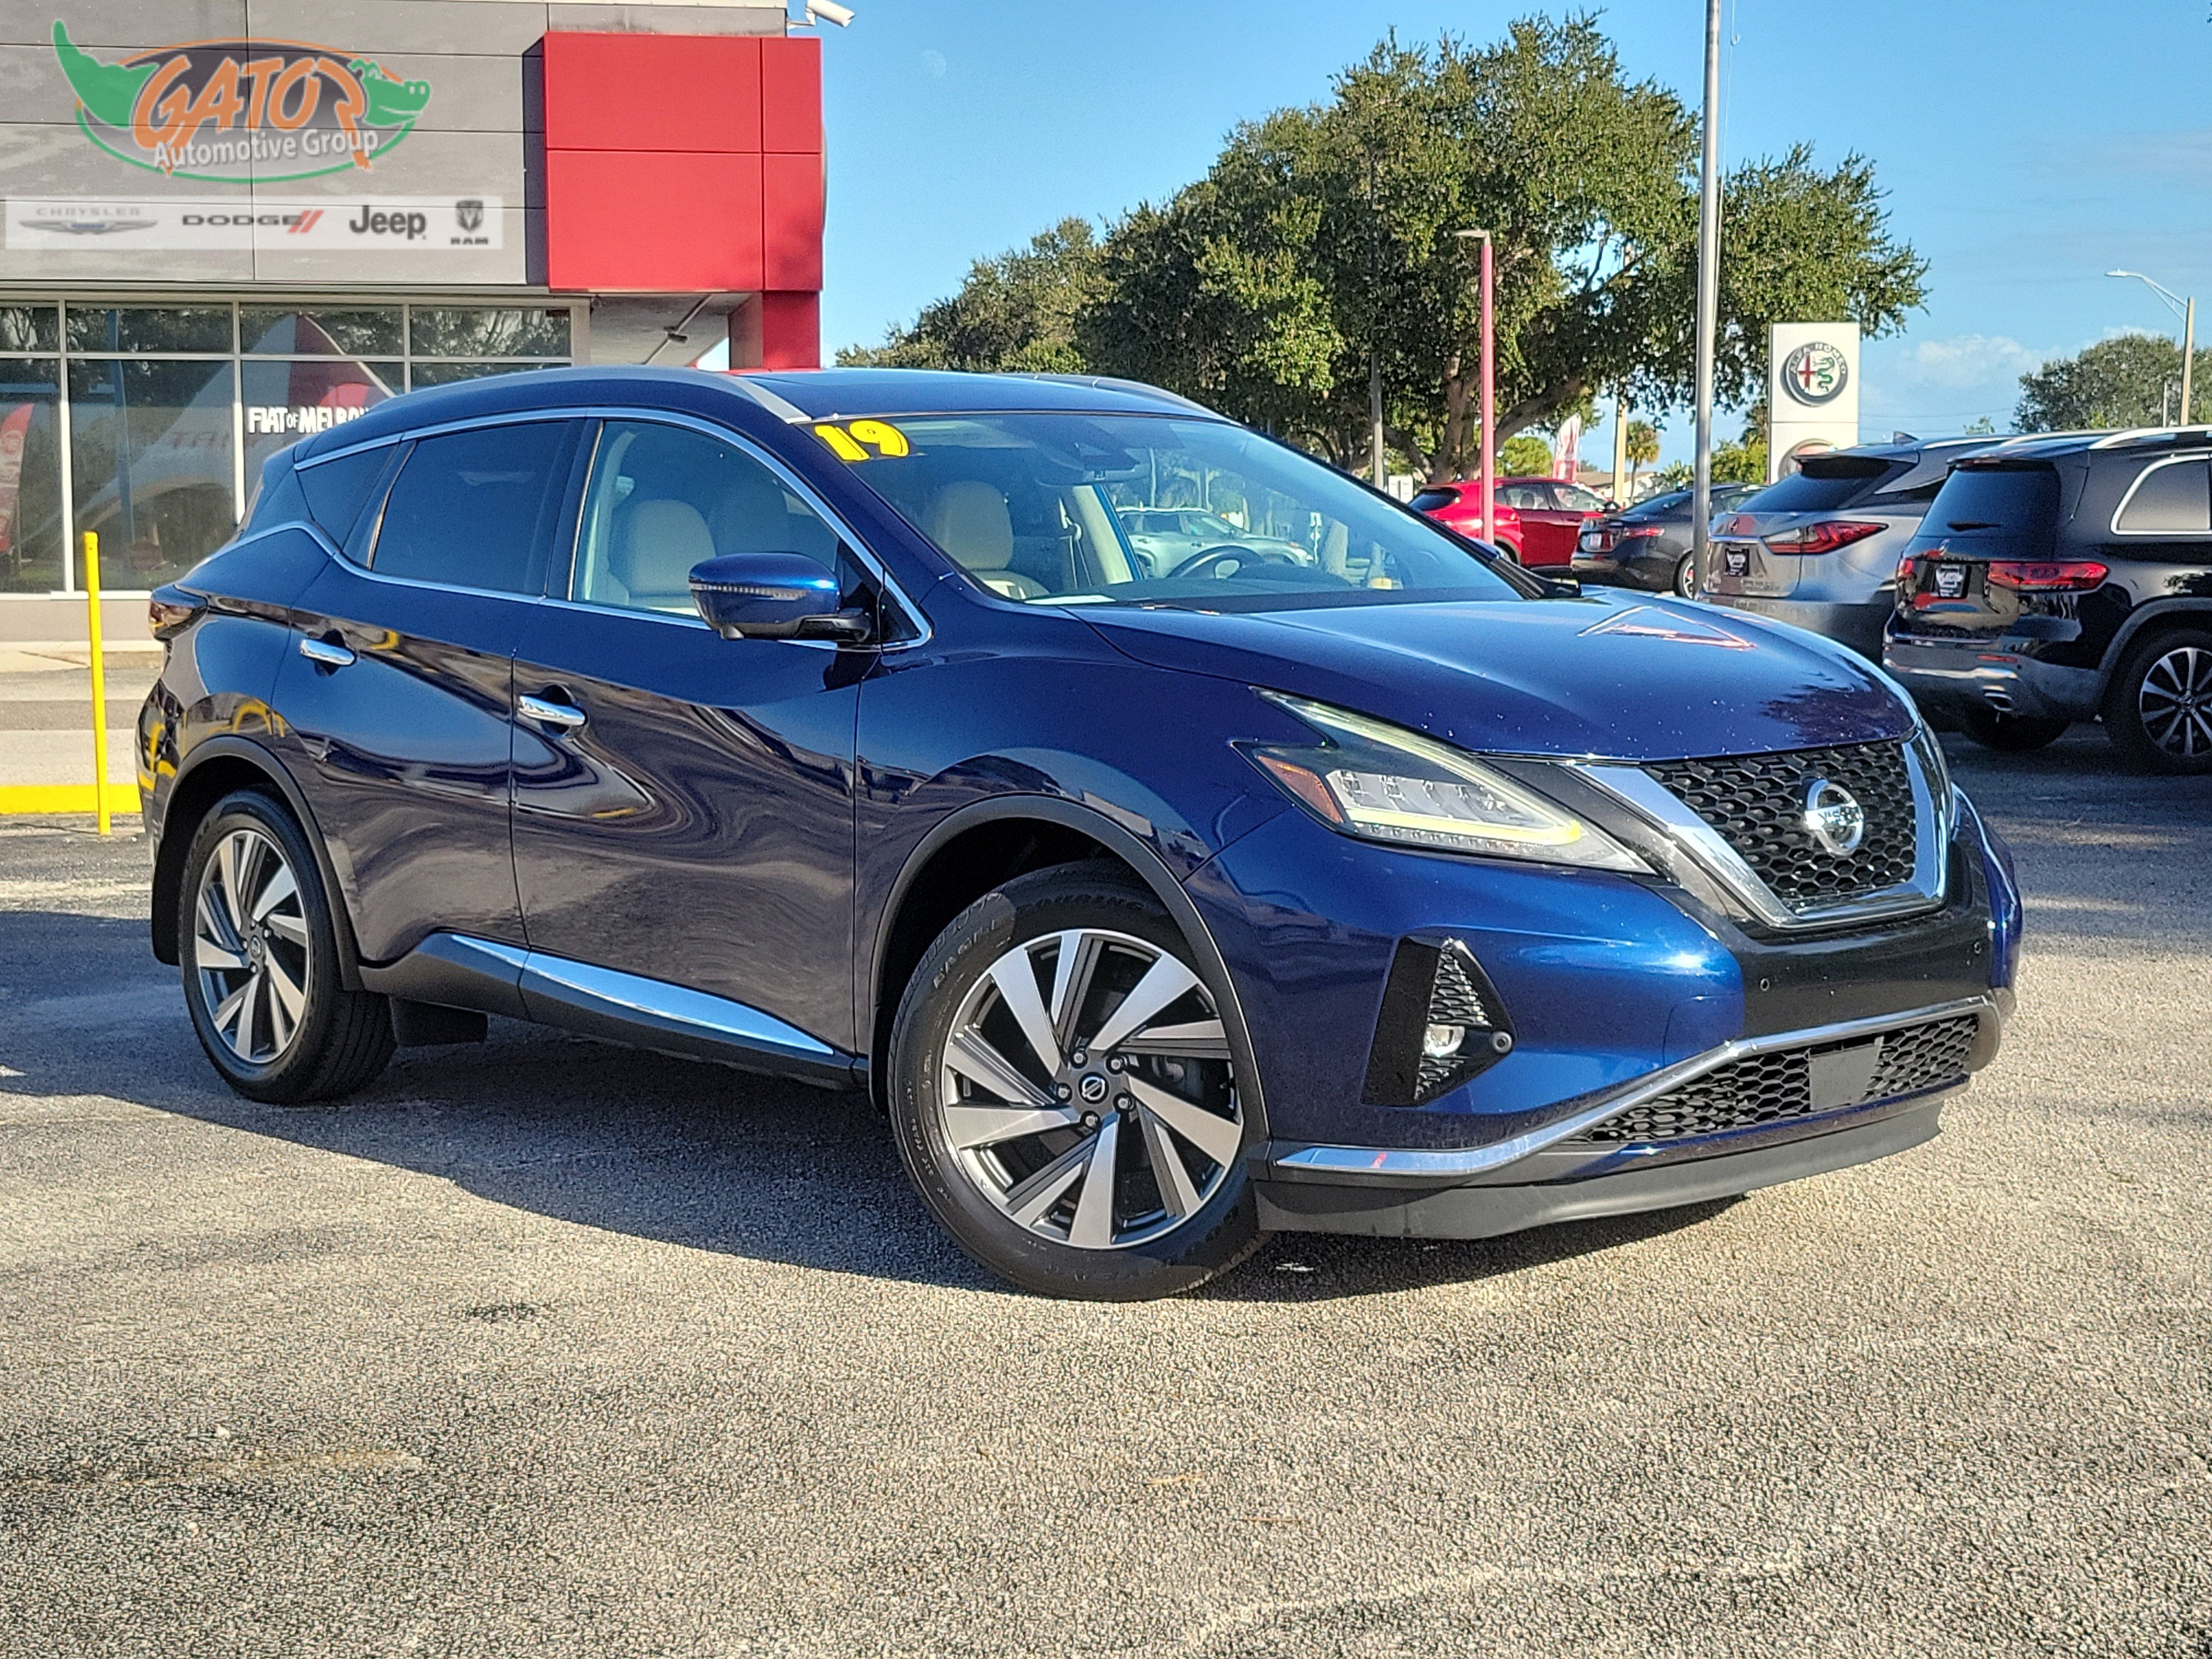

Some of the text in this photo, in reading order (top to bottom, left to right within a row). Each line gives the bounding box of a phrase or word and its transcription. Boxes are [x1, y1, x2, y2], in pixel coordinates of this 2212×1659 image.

[1789, 347, 1810, 374] ALFA
[249, 406, 370, 433] FIAT OF MELBO
[814, 420, 909, 461] 19
